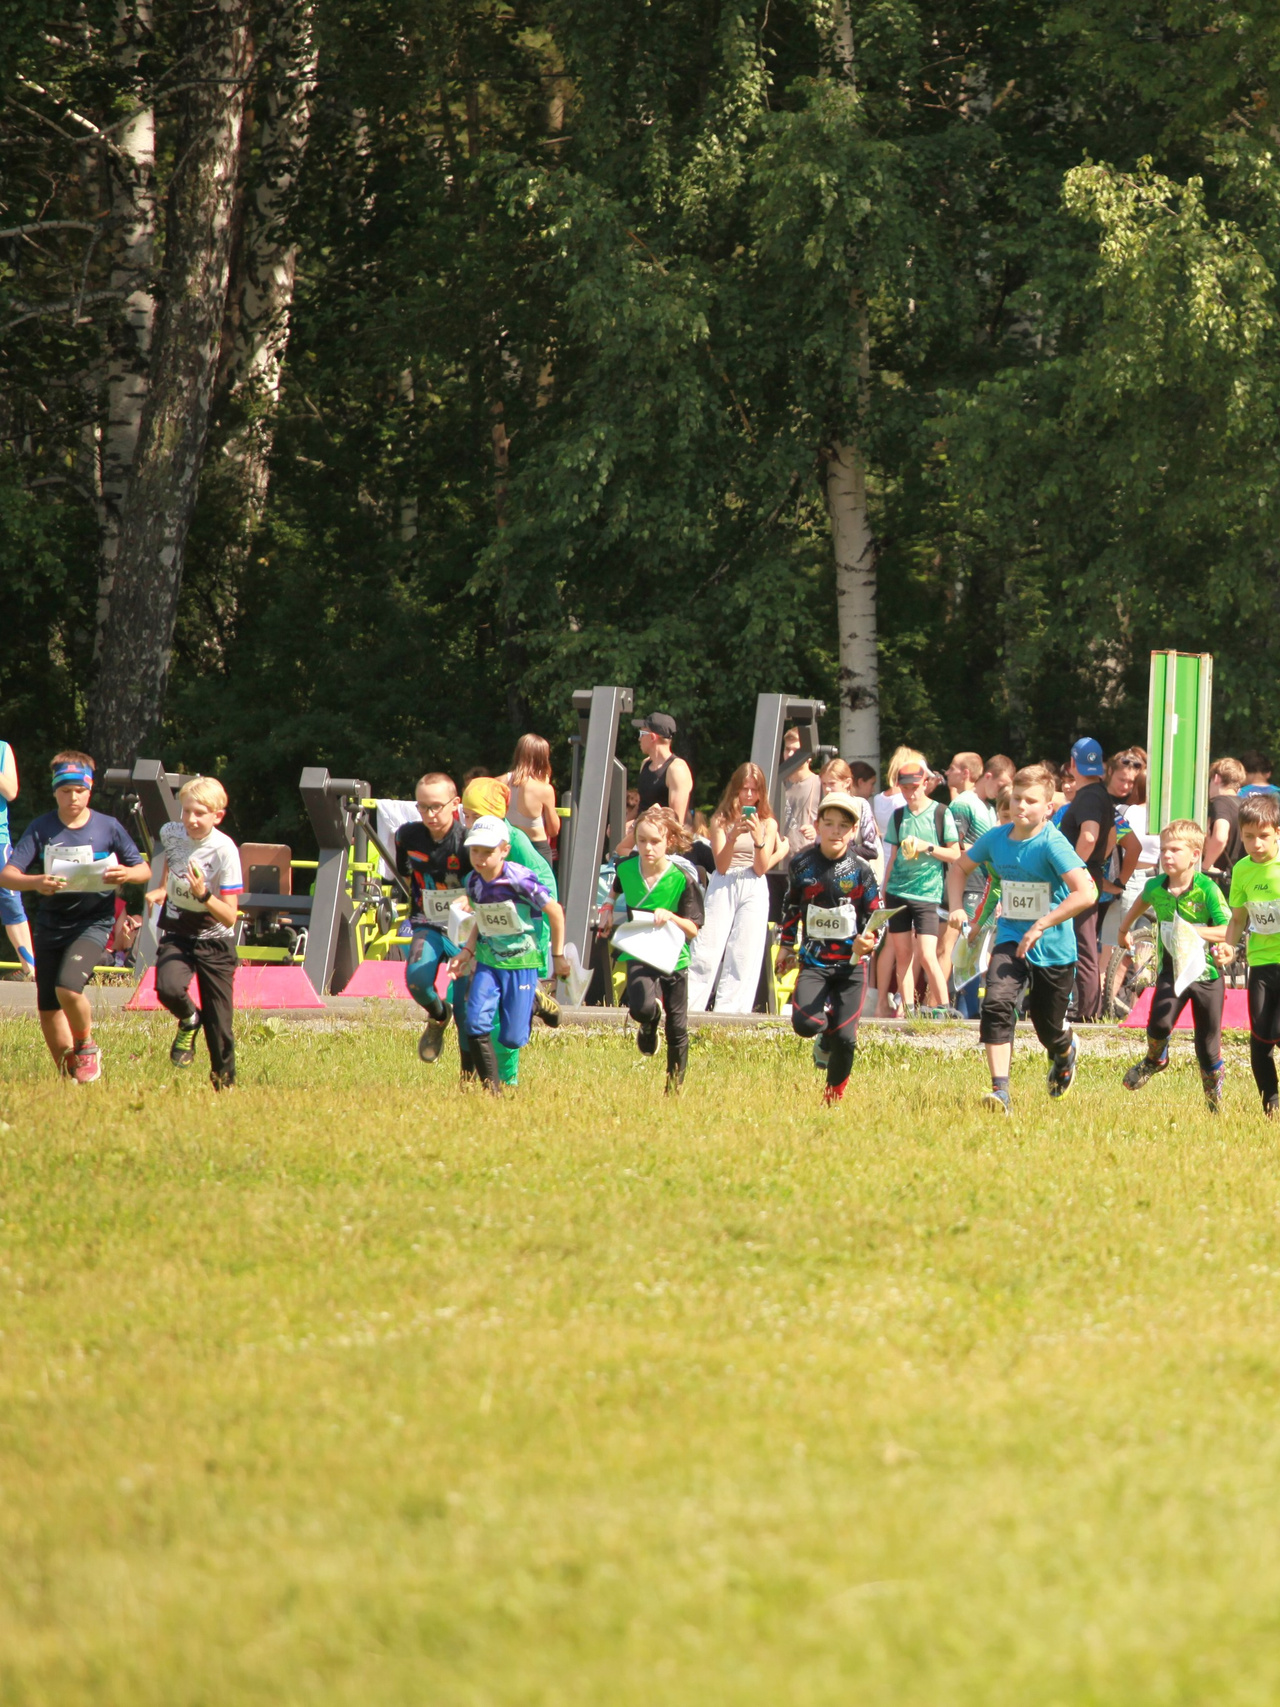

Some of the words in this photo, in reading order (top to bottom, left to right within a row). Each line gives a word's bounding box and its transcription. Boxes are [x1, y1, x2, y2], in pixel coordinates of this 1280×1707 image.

[1012, 896, 1034, 909] 647
[486, 914, 508, 926] 645
[816, 918, 840, 930] 646
[1255, 912, 1276, 926] 654
